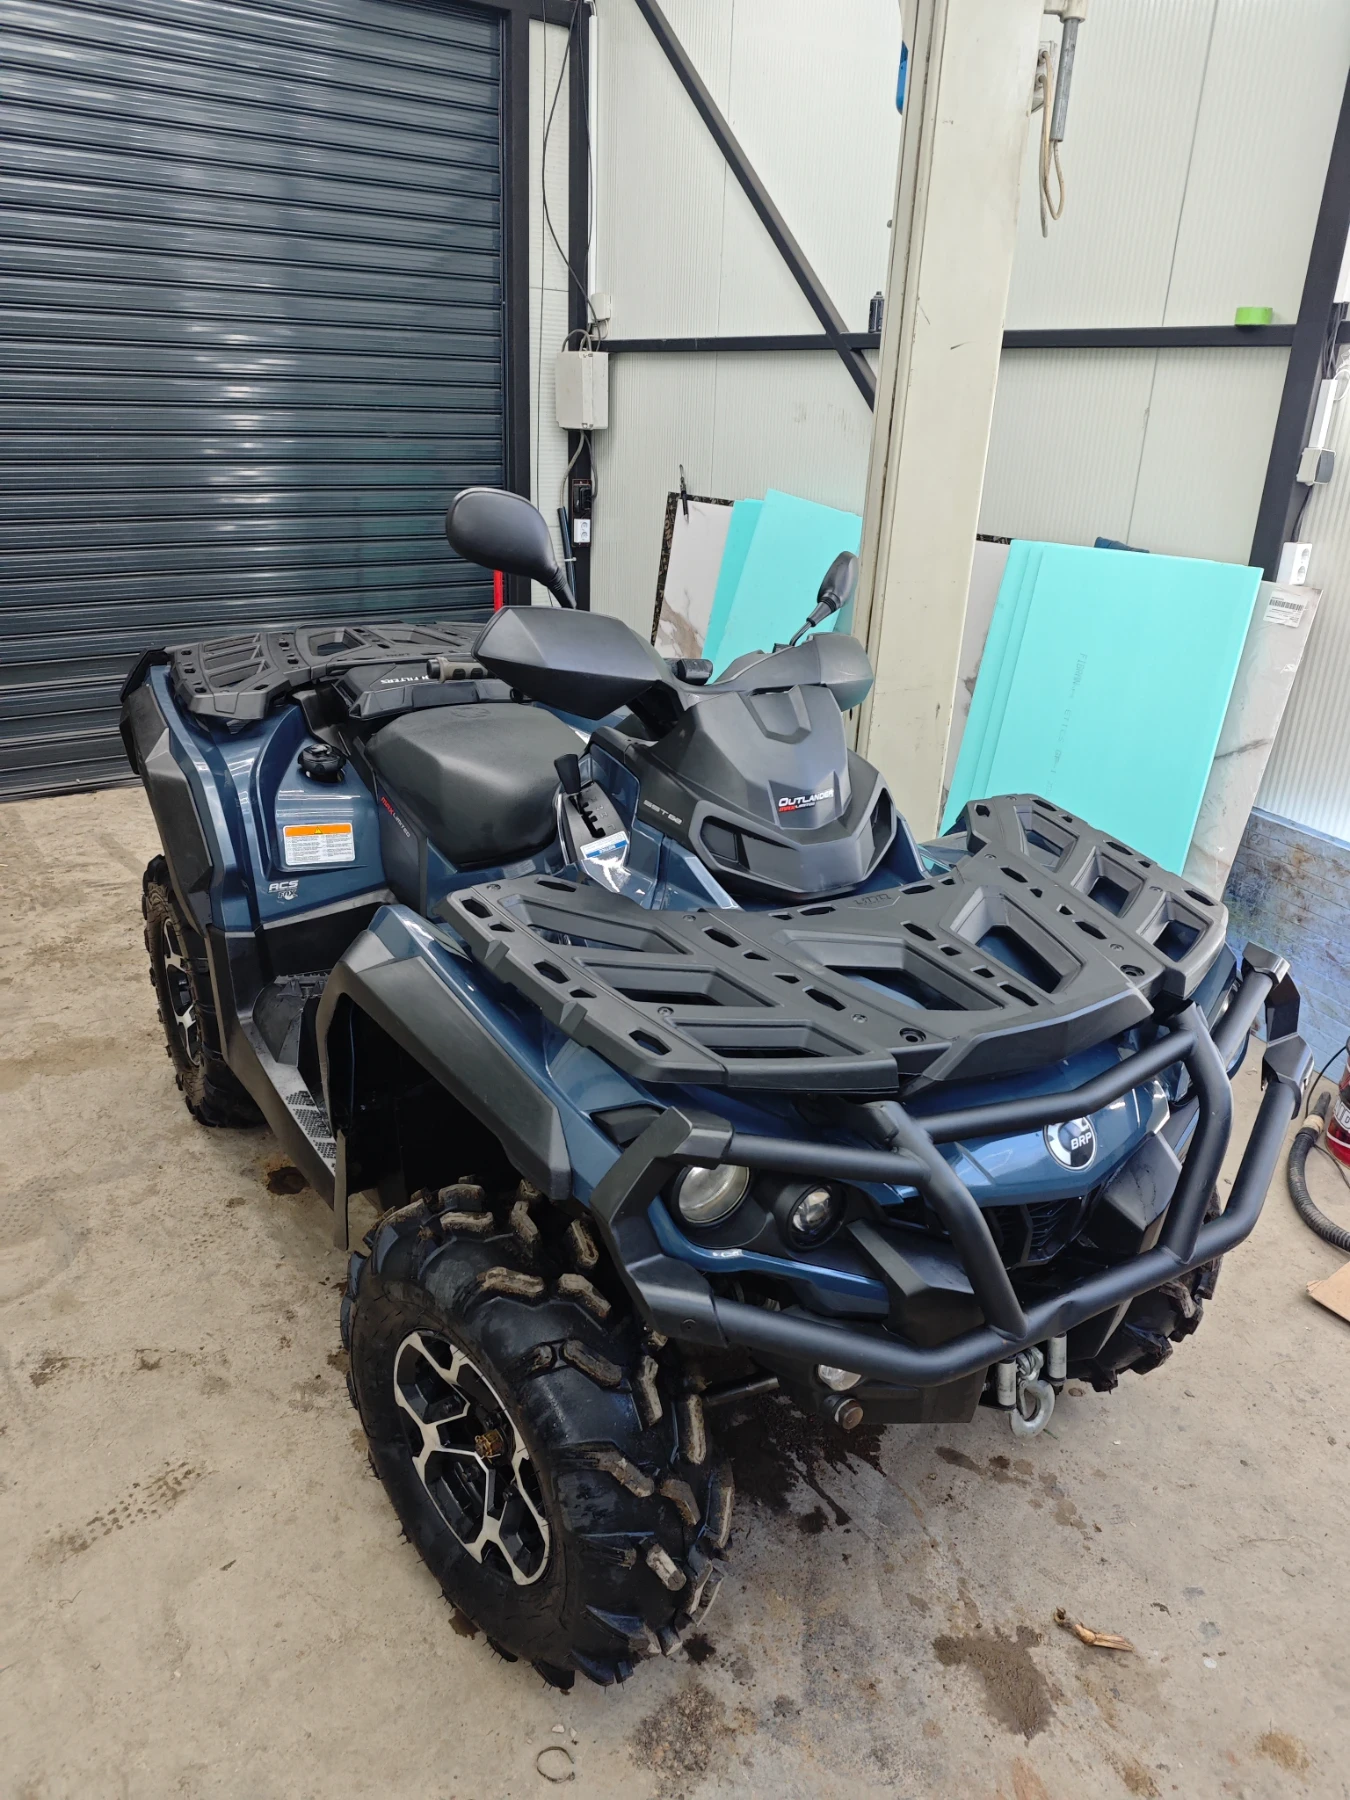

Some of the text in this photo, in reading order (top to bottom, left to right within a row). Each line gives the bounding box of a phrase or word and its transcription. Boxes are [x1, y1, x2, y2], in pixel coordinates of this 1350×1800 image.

[778, 788, 835, 807] OUTLANDER
[381, 796, 411, 838] MAX LIMITED
[268, 879, 299, 892] ACS
[1070, 1131, 1092, 1151] BRP
